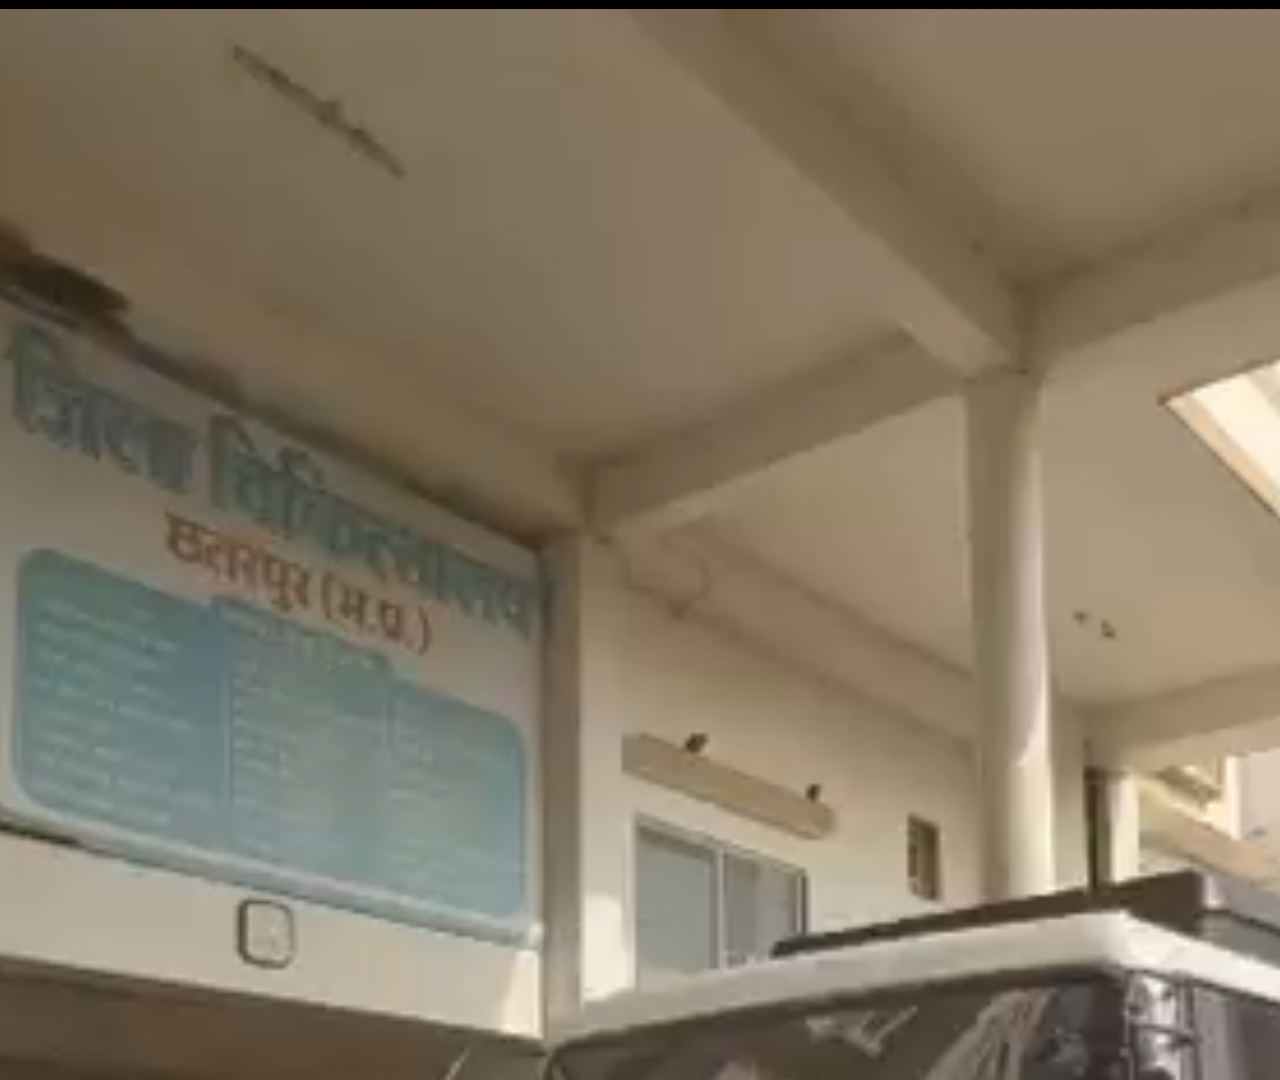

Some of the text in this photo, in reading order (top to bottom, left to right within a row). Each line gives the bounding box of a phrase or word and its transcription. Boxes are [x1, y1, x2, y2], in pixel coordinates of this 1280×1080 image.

[4, 322, 554, 640] जिला चिकित्सालय
[165, 510, 315, 614] छतरपुर
